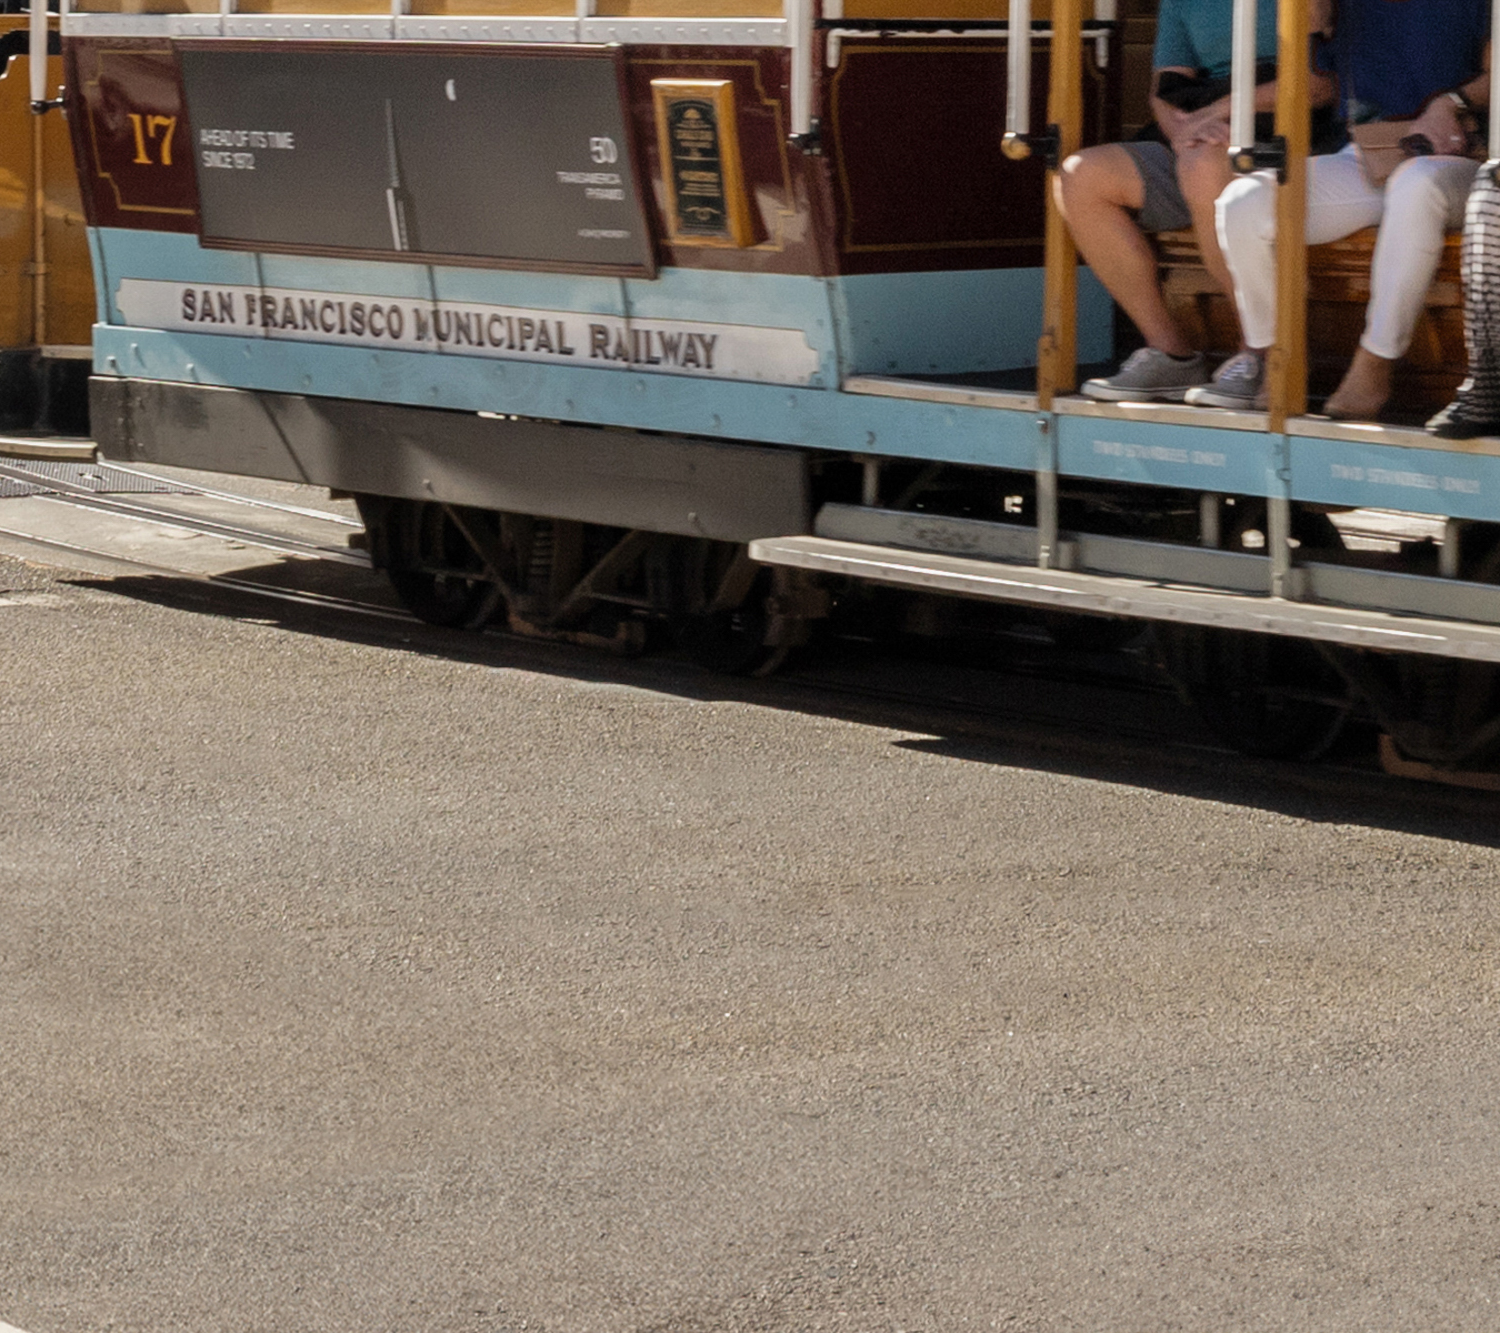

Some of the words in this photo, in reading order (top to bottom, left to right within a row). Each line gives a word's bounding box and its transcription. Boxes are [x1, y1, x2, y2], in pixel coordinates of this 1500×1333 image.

[127, 113, 176, 166] 17
[182, 288, 234, 325] SAN
[245, 293, 403, 340] FRANCISCO
[414, 307, 575, 356] MUNICIPAL
[589, 323, 719, 370] RAILWAY
